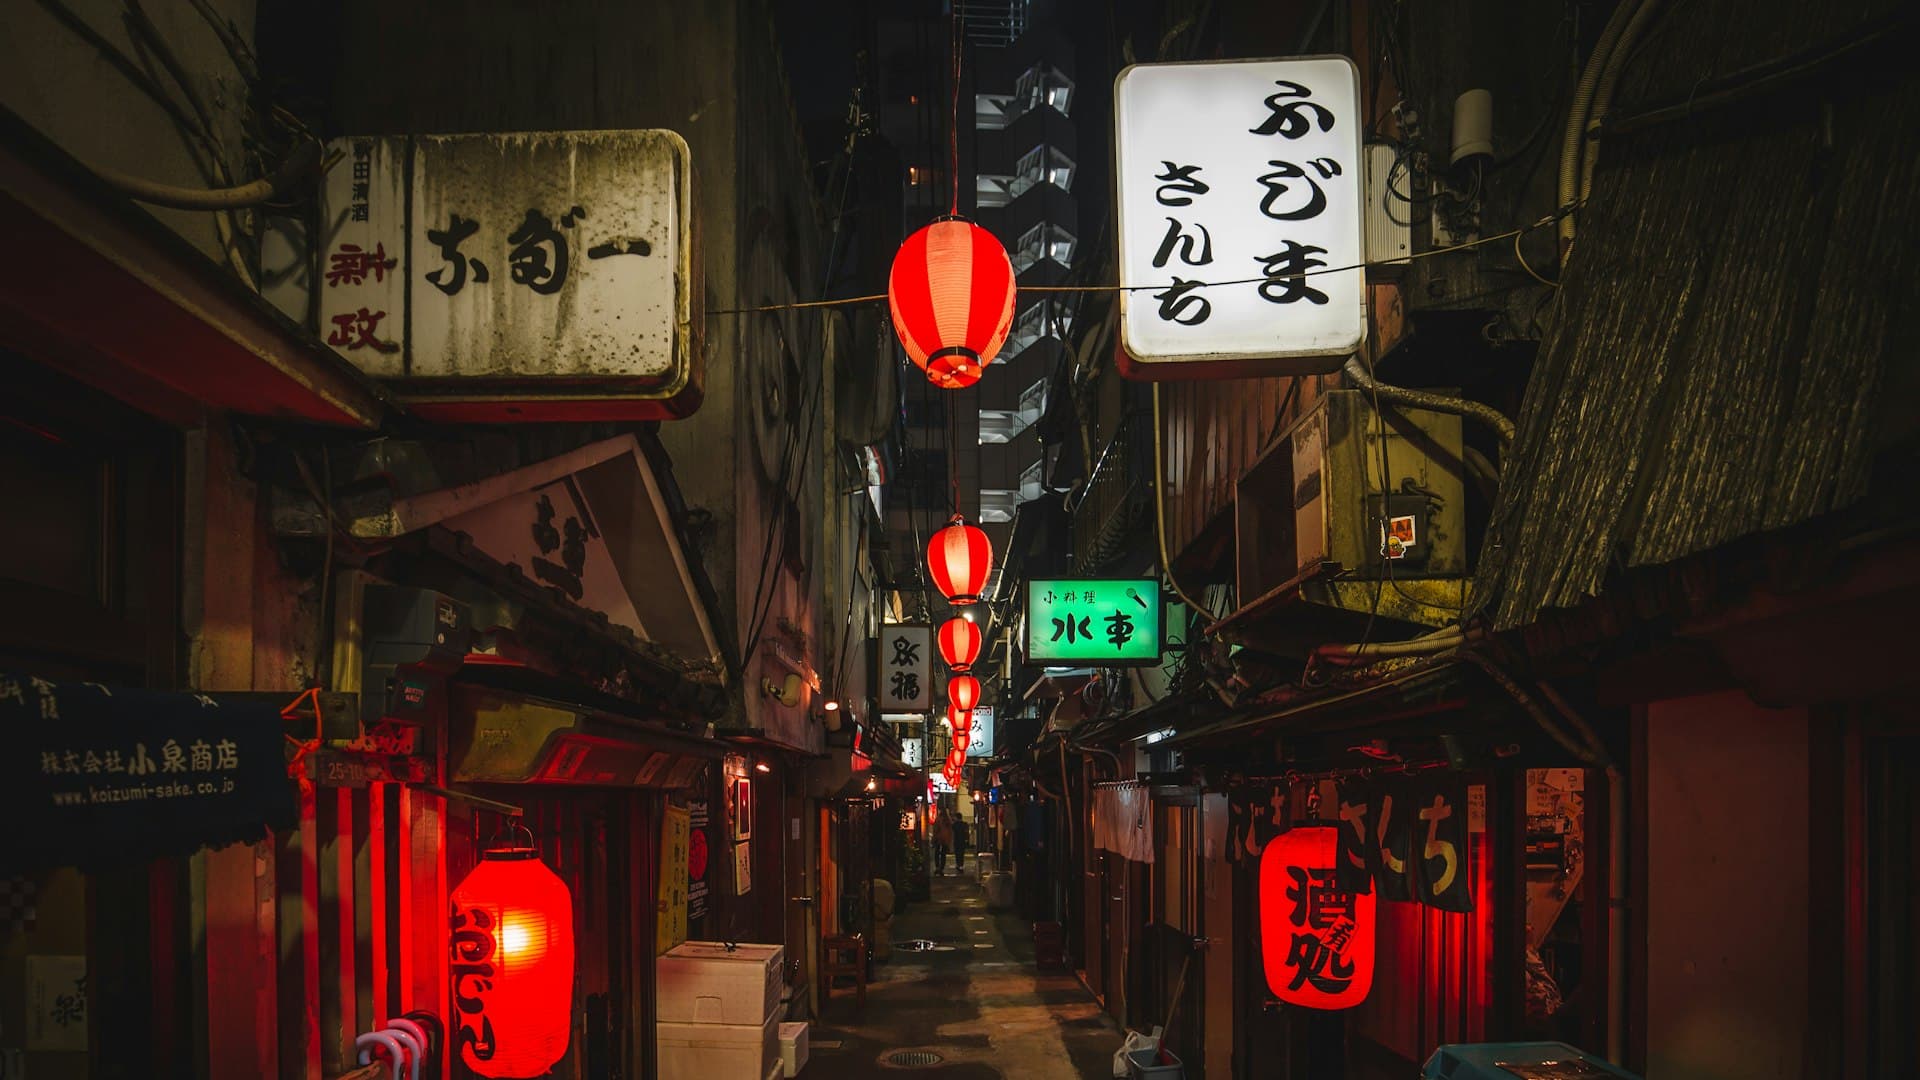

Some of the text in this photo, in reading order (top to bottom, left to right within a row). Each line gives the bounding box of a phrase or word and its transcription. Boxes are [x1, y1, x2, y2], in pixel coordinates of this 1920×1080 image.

[1249, 80, 1342, 304] ふじま
[1152, 160, 1214, 325] さんち
[1043, 590, 1097, 605] 小料理
[1050, 608, 1135, 651] 水車
[40, 739, 239, 776] 株式会社小泉商店
[53, 778, 235, 806] www.koizumi-sake.co.jp
